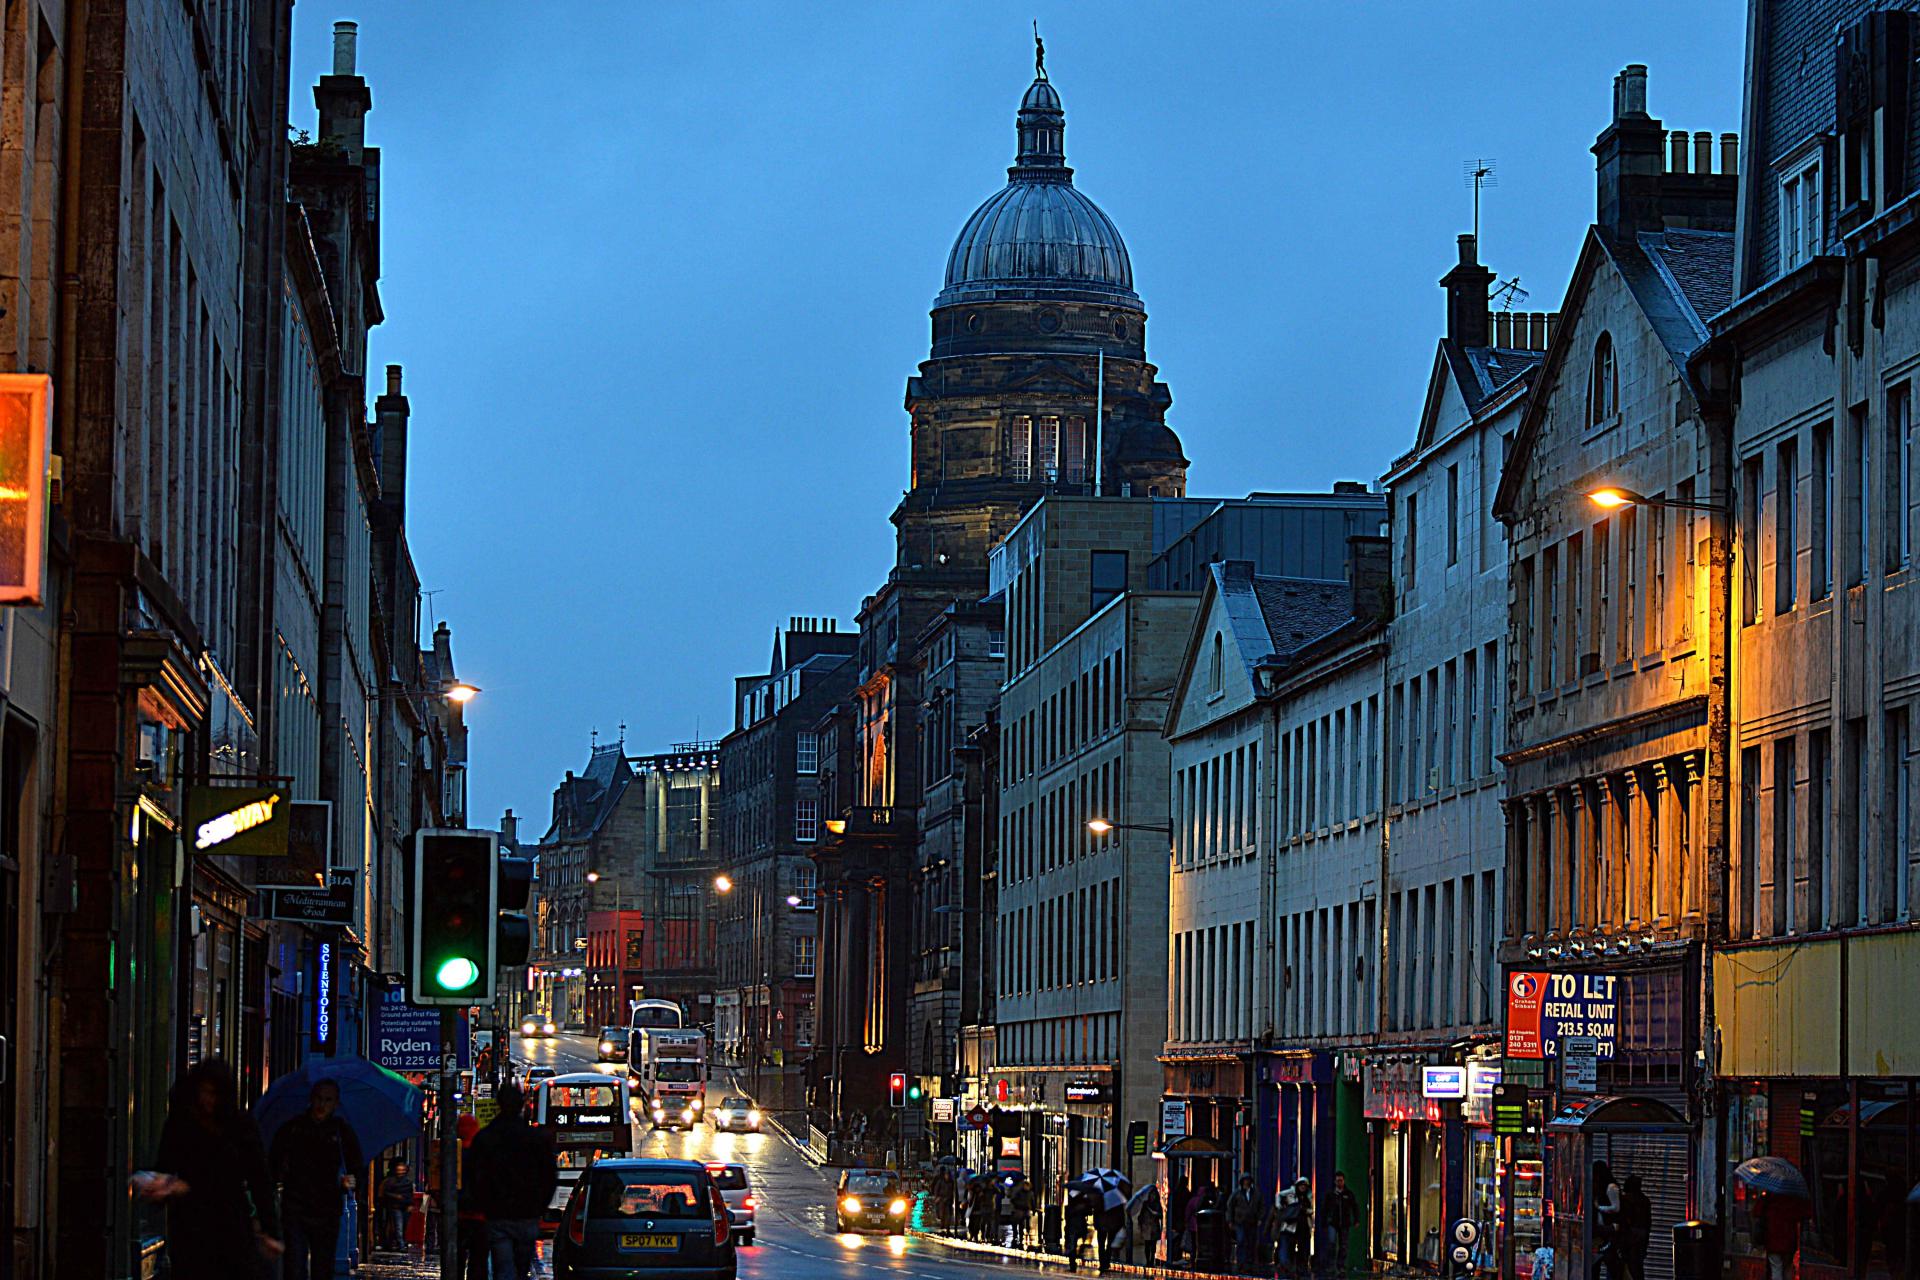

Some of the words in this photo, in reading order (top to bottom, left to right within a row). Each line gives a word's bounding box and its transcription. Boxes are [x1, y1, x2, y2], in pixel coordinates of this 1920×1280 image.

[195, 793, 281, 850] SUBWAY
[302, 906, 326, 917] Food
[320, 943, 330, 1041] SCIENTOLOGY
[1551, 974, 1576, 999] TO
[1583, 975, 1616, 1000] LET
[1545, 1002, 1584, 1018] RETAIL
[1587, 1003, 1615, 1019] UNIT
[1556, 1021, 1584, 1036] 213.5
[1587, 1022, 1614, 1039] SQ.M
[381, 1038, 431, 1055] Ryden
[381, 1056, 402, 1066] 0131
[405, 1056, 425, 1065] 225
[1067, 1087, 1099, 1095] Sainsbury's
[558, 1114, 567, 1124] 31
[625, 1236, 651, 1245] SP07
[654, 1236, 673, 1245] YKK
